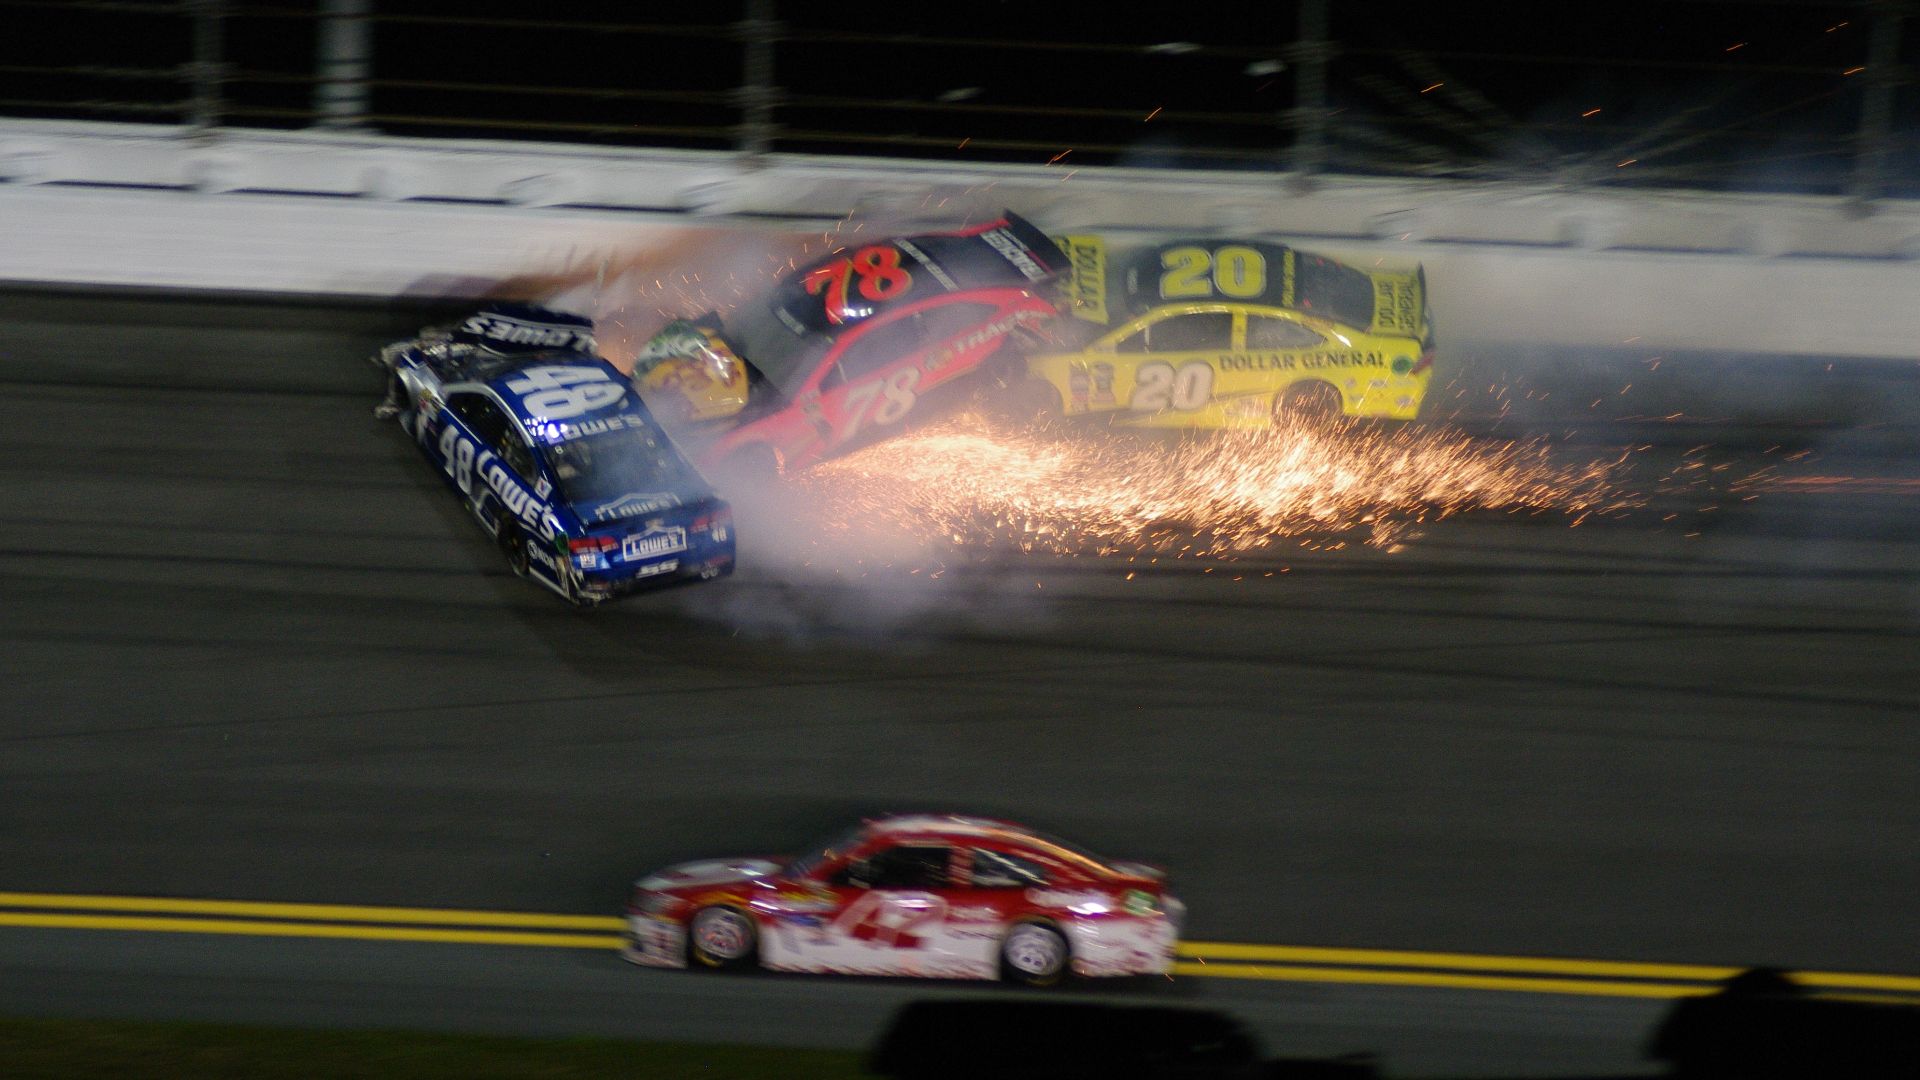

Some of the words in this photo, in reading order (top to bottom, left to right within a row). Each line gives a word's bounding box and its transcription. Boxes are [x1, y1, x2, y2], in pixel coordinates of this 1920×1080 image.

[804, 245, 913, 324] 78
[1159, 245, 1268, 300] 20
[1132, 361, 1215, 411] 20
[1218, 353, 1296, 371] DOLLAR
[1301, 351, 1386, 370] GENERAL
[505, 365, 628, 422] 48
[838, 365, 923, 442] 78
[438, 424, 476, 496] 48
[476, 449, 560, 542] LOWE'S
[712, 526, 728, 543] 48
